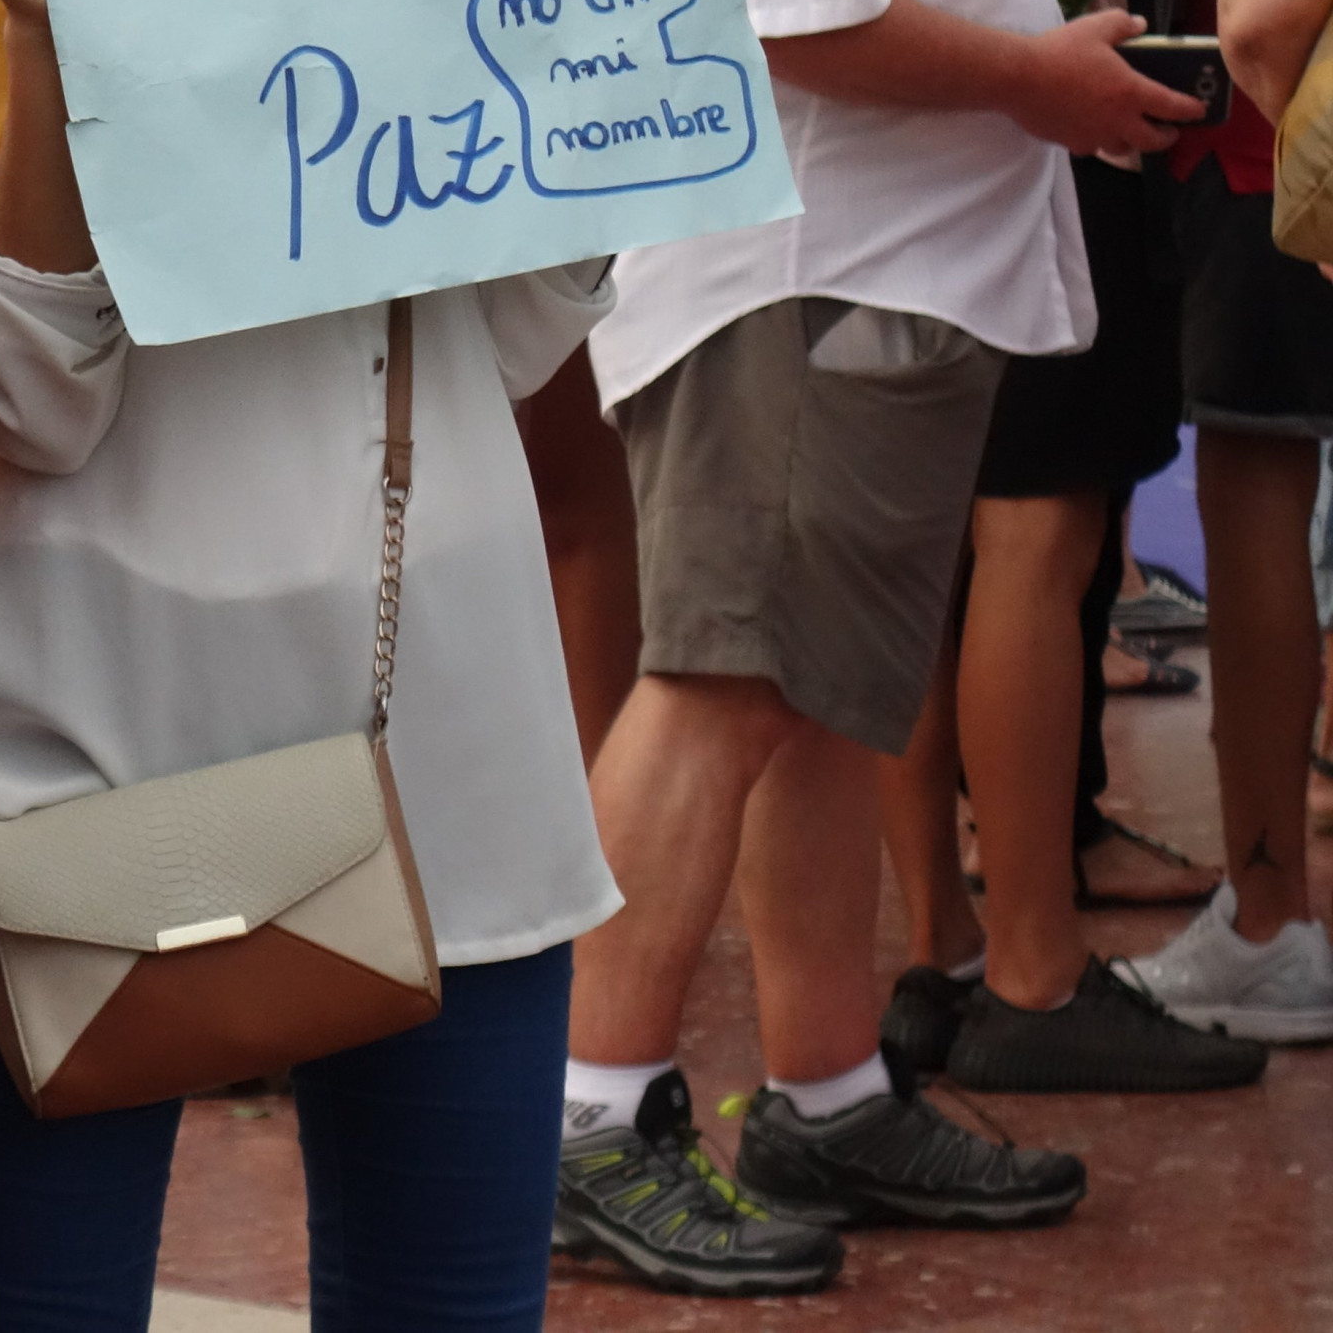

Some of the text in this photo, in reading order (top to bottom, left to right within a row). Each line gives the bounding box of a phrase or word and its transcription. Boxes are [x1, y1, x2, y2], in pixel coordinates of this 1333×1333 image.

[549, 37, 638, 83] mi
[259, 44, 515, 262] Paz
[546, 98, 731, 158] nombre
